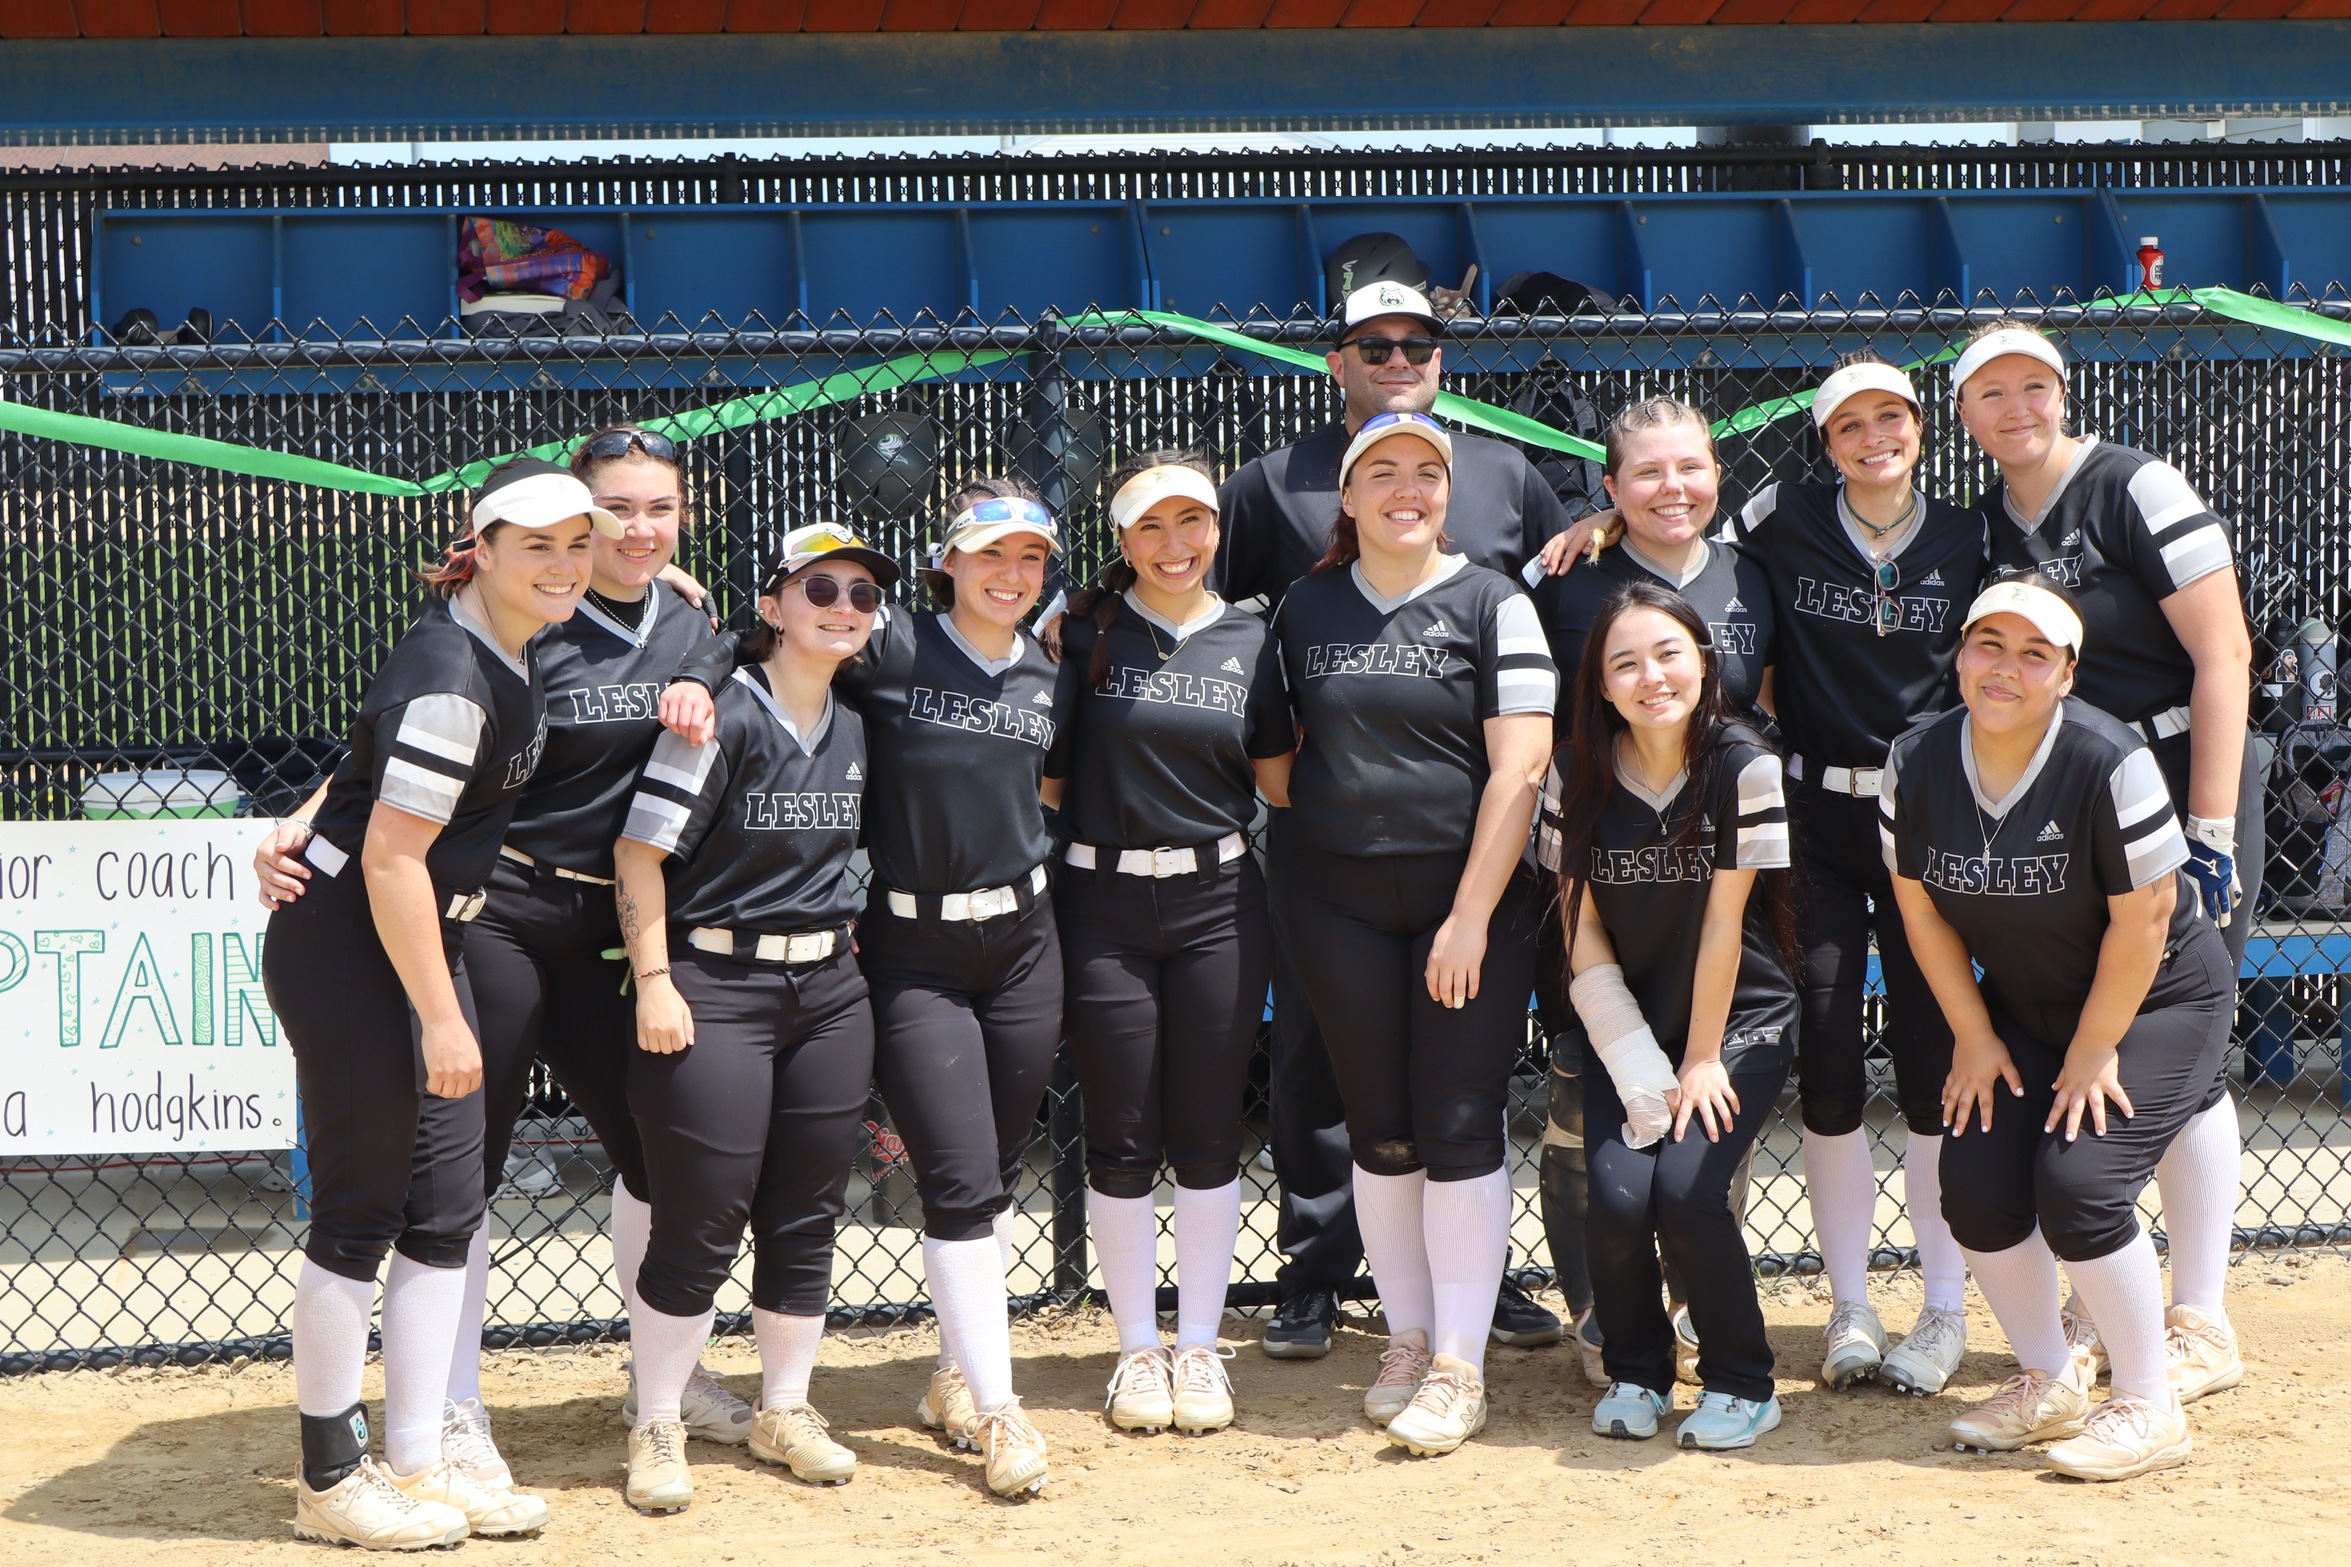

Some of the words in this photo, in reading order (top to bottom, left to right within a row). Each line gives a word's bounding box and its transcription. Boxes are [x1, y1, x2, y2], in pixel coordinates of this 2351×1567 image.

[1795, 576, 1950, 633] LESLEY
[1920, 578, 1945, 587] adidas
[1423, 629, 1450, 638] adidas
[1220, 664, 1245, 676] adidas
[1305, 643, 1449, 680] LESLEY
[569, 682, 671, 724] LESL
[1095, 666, 1248, 718] LESLEY
[909, 687, 1057, 751] LESLEY
[2036, 832, 2065, 842] adidas
[97, 841, 234, 901] coach
[1923, 846, 2069, 896] LESLEY
[4, 1091, 27, 1137] a
[91, 1070, 283, 1142] hodgkins.
